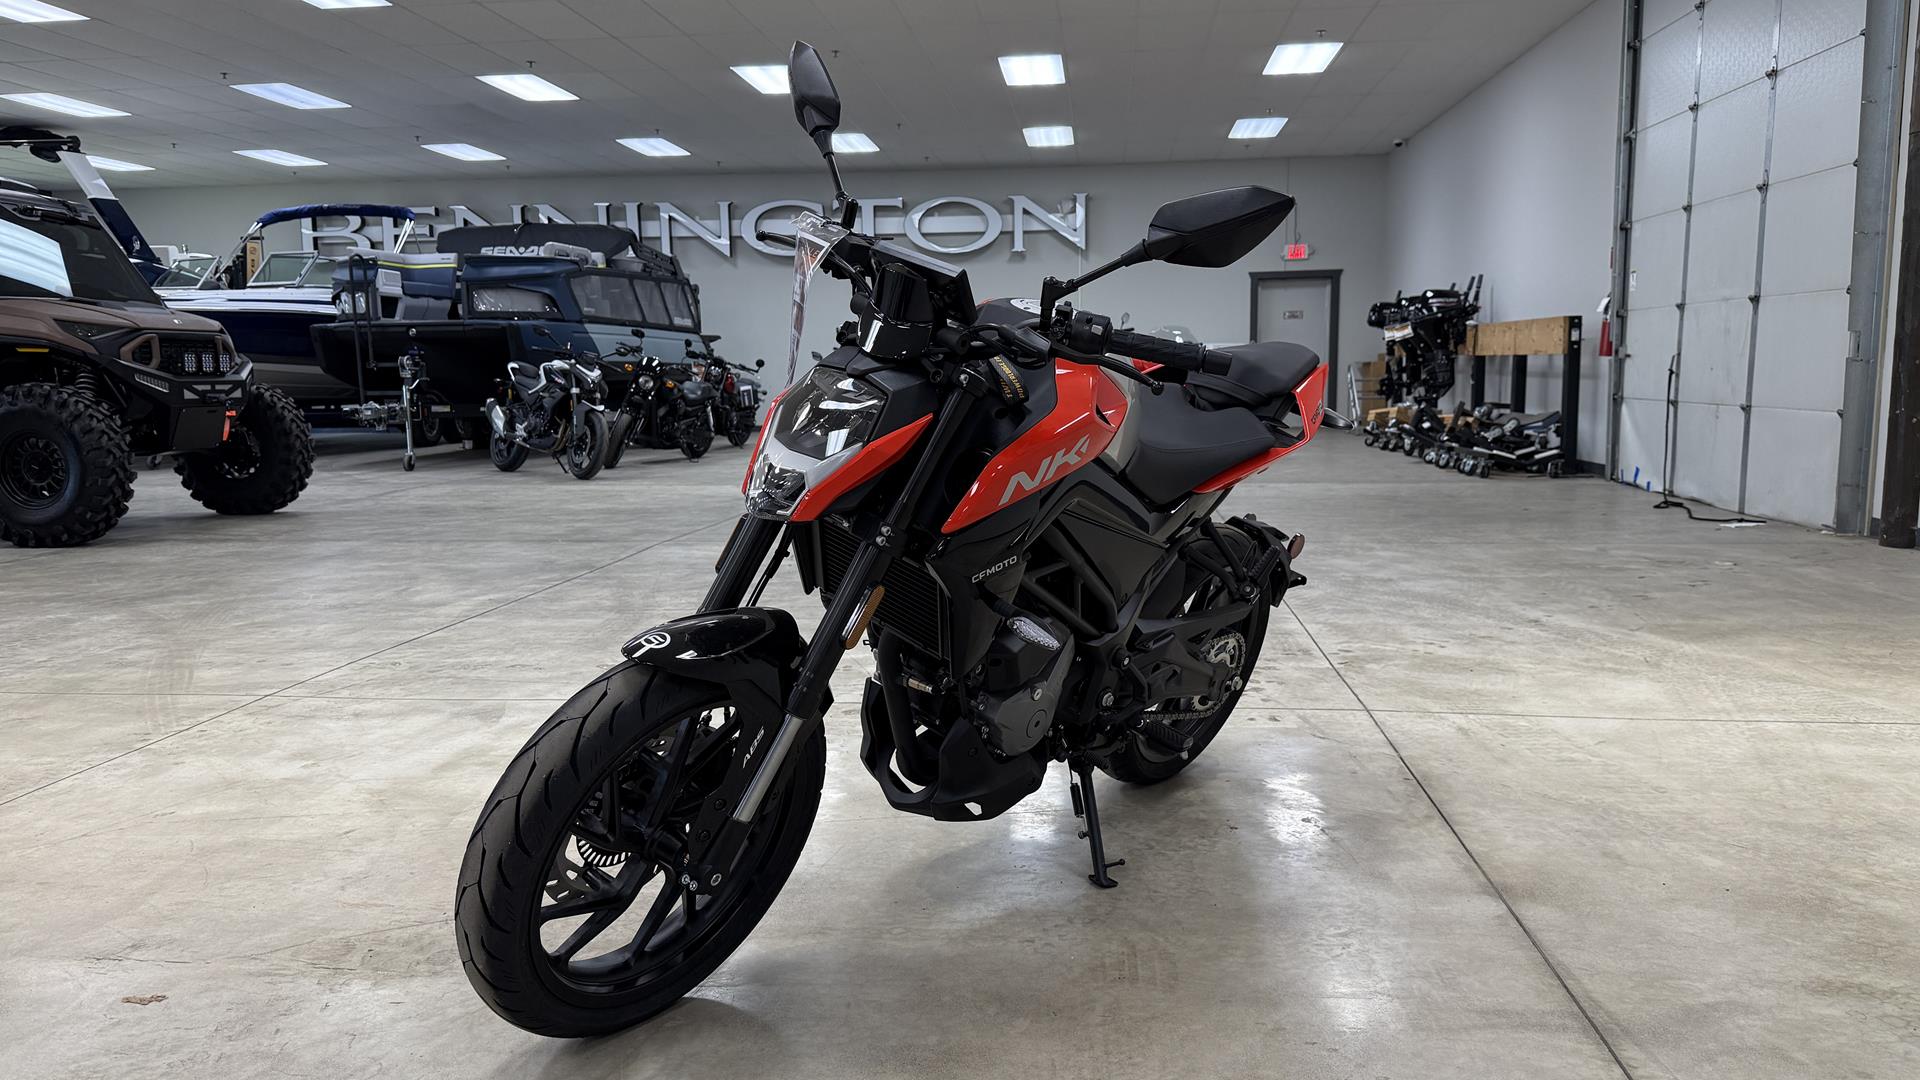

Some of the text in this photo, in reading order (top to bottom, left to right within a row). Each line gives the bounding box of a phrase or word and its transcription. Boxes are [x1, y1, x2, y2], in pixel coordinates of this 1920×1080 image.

[998, 433, 1090, 507] NK
[971, 555, 1017, 584] CFMOTO
[742, 725, 765, 769] ABS
